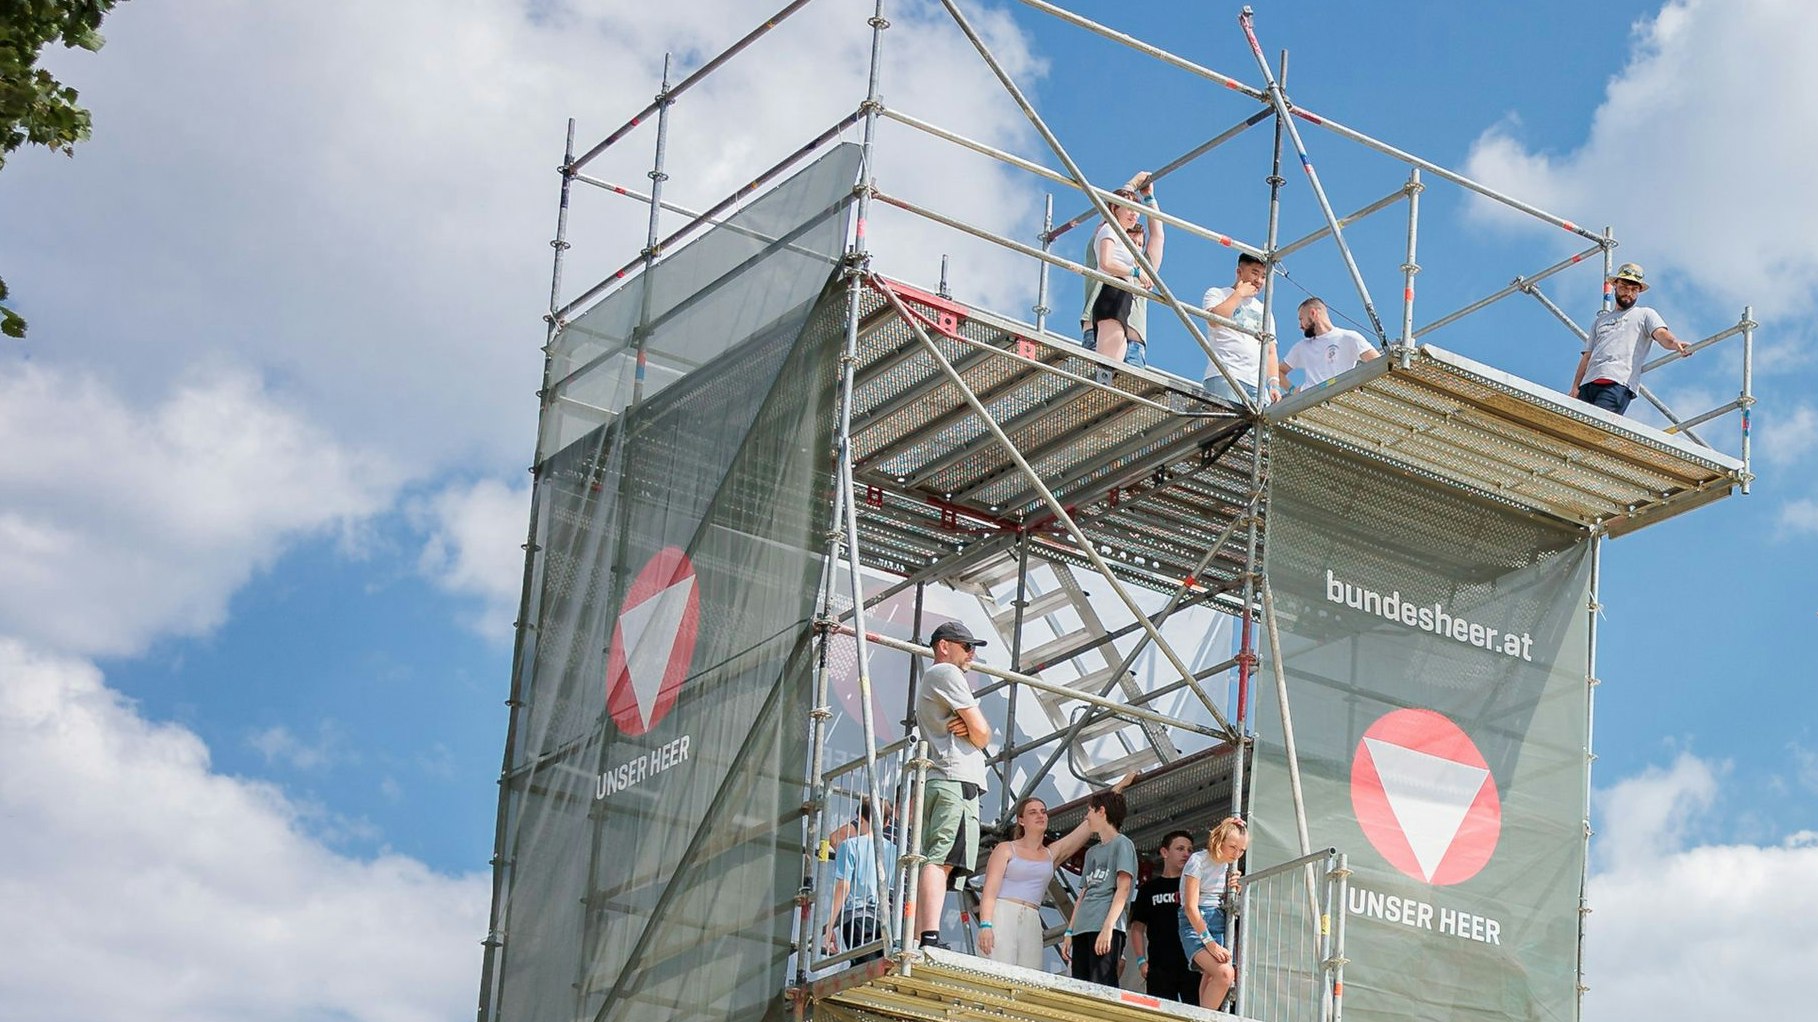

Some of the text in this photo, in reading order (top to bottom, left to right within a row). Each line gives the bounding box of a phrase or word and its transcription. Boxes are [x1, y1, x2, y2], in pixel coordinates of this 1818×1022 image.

[1326, 569, 1534, 662] bundesheer.at
[596, 734, 690, 800] UNSER HEER
[1348, 886, 1501, 946] UNSER HEER
